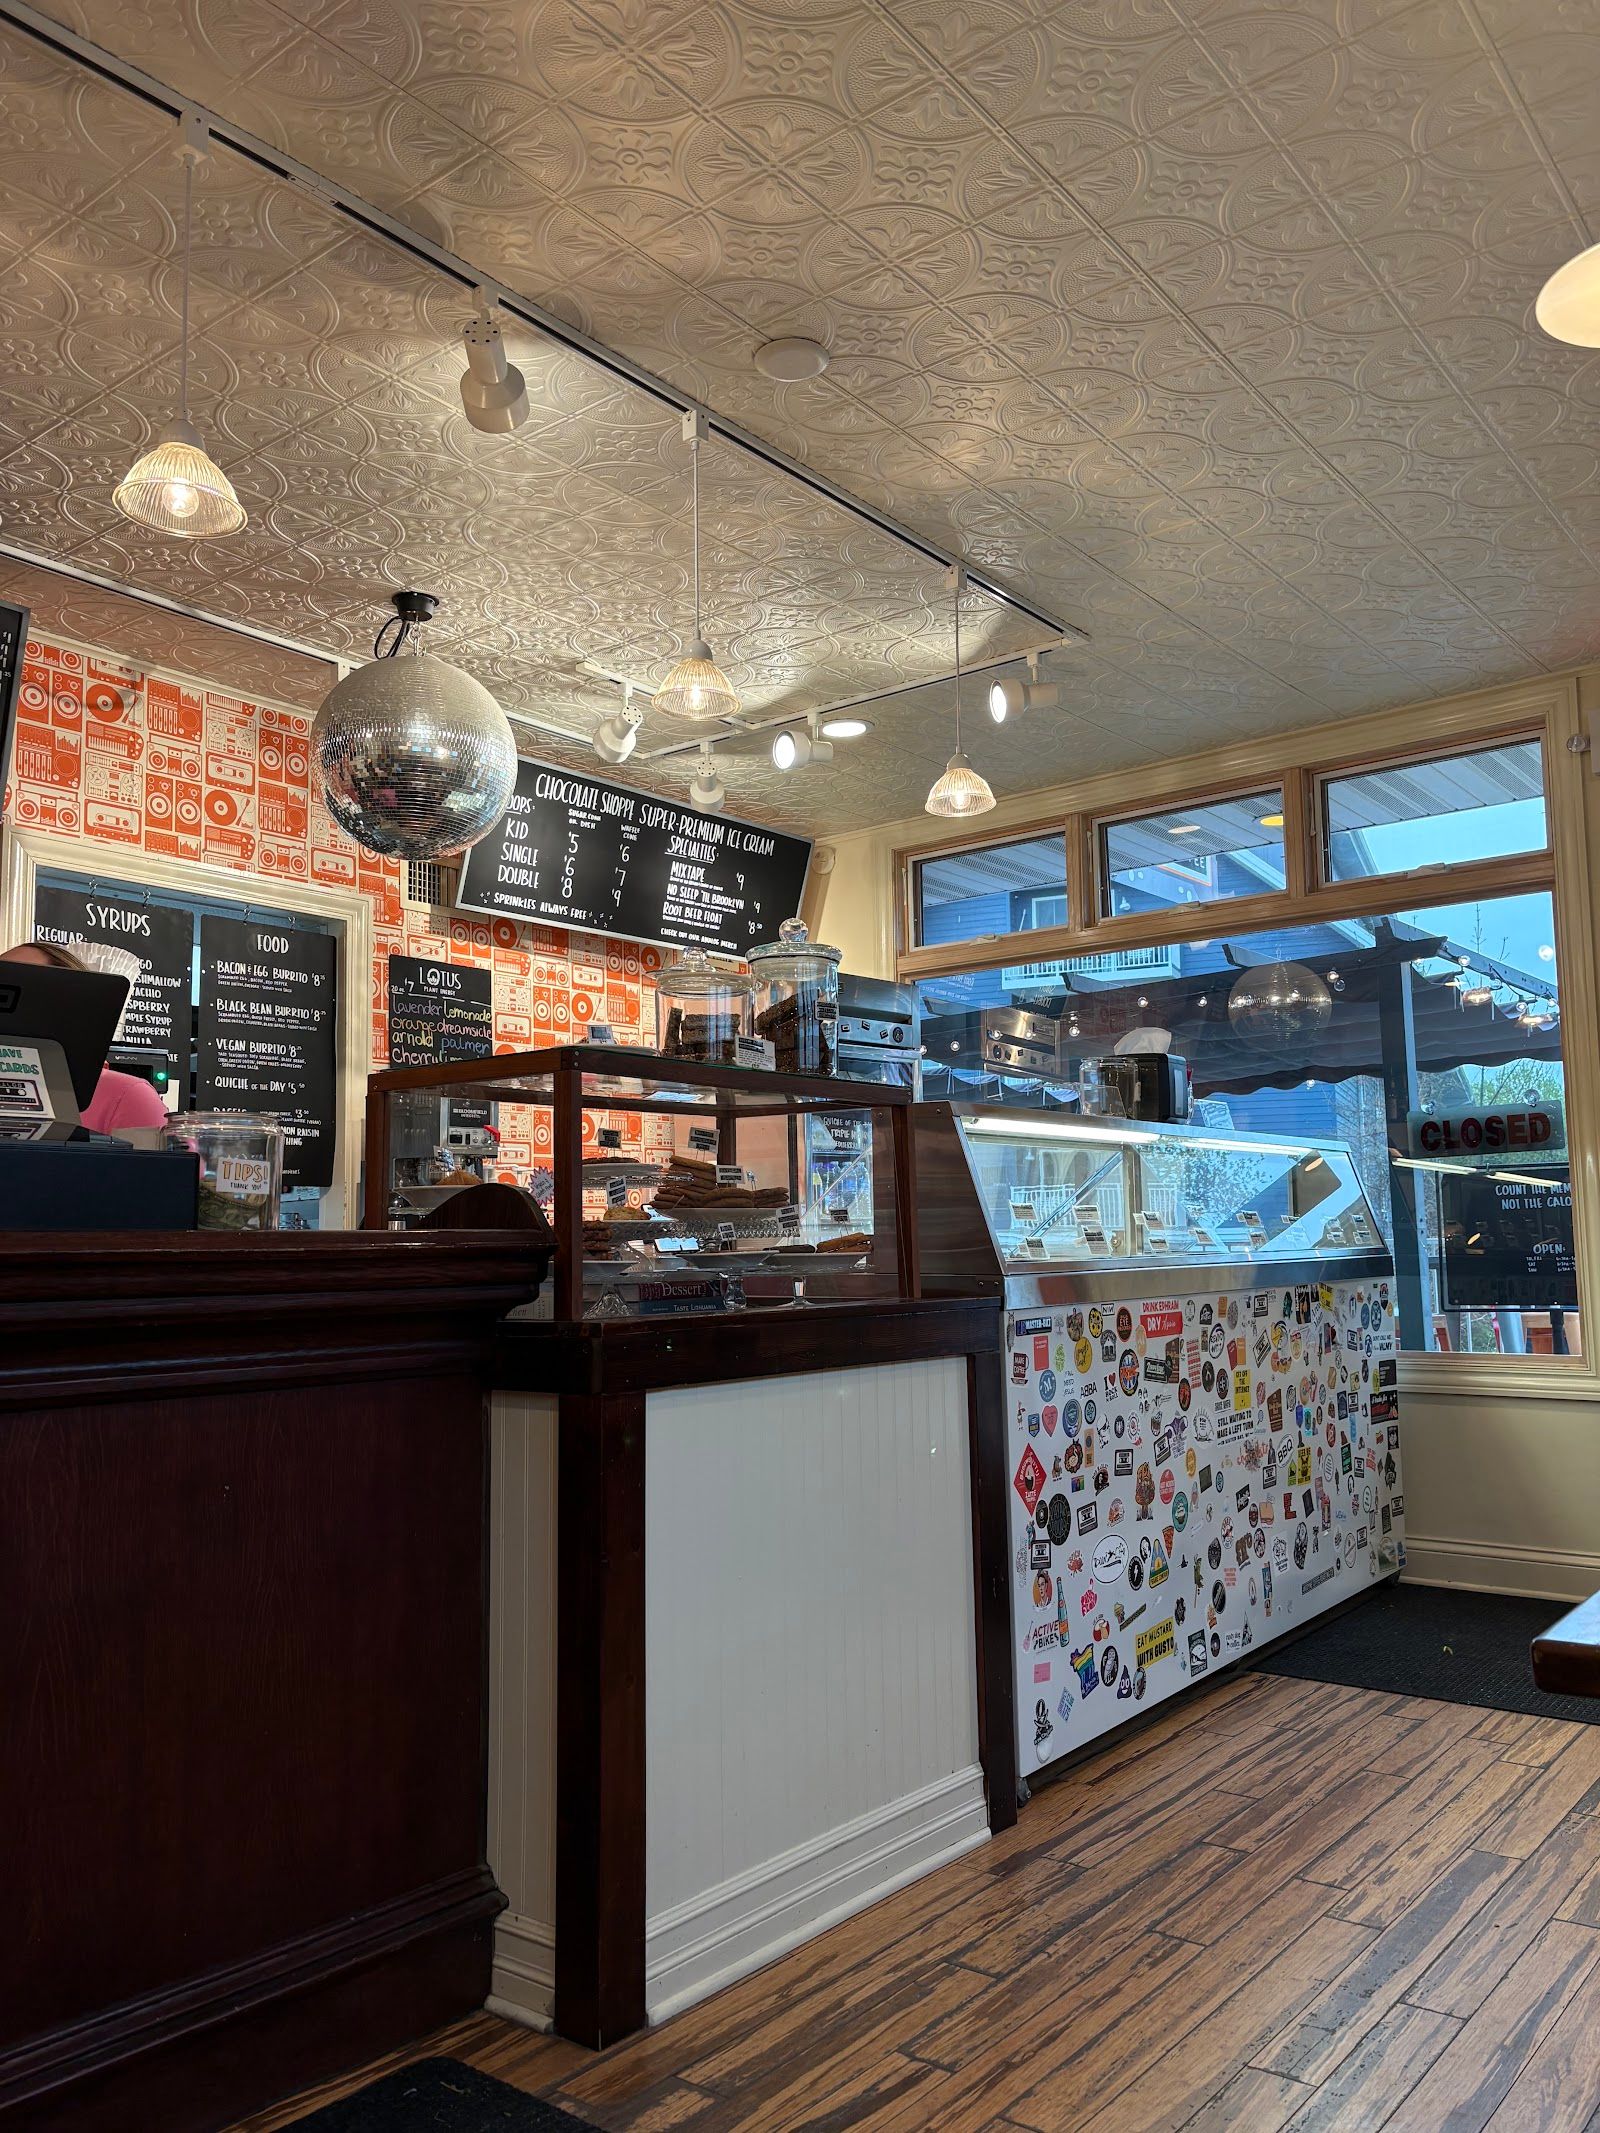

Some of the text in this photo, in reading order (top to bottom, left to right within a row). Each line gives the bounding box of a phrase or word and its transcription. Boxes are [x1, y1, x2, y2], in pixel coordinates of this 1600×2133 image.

[507, 795, 535, 813] OOPS:
[568, 809, 586, 819] SUGAR
[536, 774, 775, 856] CHOCOLATE SHOPPE SUPER-PREMIUM ICE CREAM
[580, 820, 595, 830] DISH
[620, 825, 640, 834] WAFFLE
[622, 832, 637, 841] CONE
[505, 818, 630, 862] KID $5 $6
[667, 835, 719, 862] SPECIALTIES:
[501, 842, 626, 887] SINGLE $6 $7
[498, 865, 621, 907] DOUBLE $8 $9
[670, 861, 706, 882] MIXTAPE
[736, 872, 745, 891] $9
[494, 892, 586, 920] SPRINKLES ALWAYS FREE
[667, 884, 677, 896] NO
[680, 886, 699, 900] SLEEP
[712, 894, 745, 910] BROOKLYN
[86, 902, 151, 936] SYRUPS
[662, 902, 682, 917] ROOT
[685, 907, 702, 921] BEER
[704, 912, 723, 924] FLOAT
[36, 925, 88, 944] REGULAR:
[257, 934, 289, 954] FOOD
[661, 928, 677, 937] CHECK
[701, 936, 719, 945] ANALOG
[721, 939, 738, 949] MERCH
[136, 975, 181, 988] SHMALLOW
[217, 960, 246, 975] BACON
[254, 965, 268, 977] EGG
[273, 968, 308, 984] BURRITO
[419, 966, 462, 990] LOTUS
[216, 998, 309, 1019] BLACK BEAN BURRITO
[393, 995, 492, 1023] lavender lemonade
[145, 1014, 172, 1026] SYRUP
[391, 1017, 493, 1040] orange dreamsicle
[216, 1038, 286, 1055] VEGAN BURRITO
[392, 1030, 490, 1054] arnold palmer
[215, 1075, 248, 1090] QUICHE
[270, 1081, 286, 1093] DAY
[297, 1128, 319, 1137] RAISIN
[1420, 1112, 1551, 1151] CLOSED
[222, 1160, 268, 1182] TIPS!
[1496, 1185, 1526, 1196] COUNT
[1531, 1184, 1547, 1194] THE
[1502, 1196, 1572, 1209] NOT THE CALO
[654, 1282, 701, 1296] Dessert
[674, 1304, 689, 1312] TASTE
[1143, 1302, 1158, 1312] DRINK
[1147, 1316, 1161, 1331] DRY
[1080, 1382, 1098, 1399] ABBA
[1104, 1376, 1109, 1390] I
[1105, 1386, 1117, 1397] ROCK
[1218, 1410, 1251, 1427] STILL WAITING TO
[1217, 1428, 1228, 1439] MAKE
[1232, 1423, 1242, 1434] LEFT
[1243, 1421, 1254, 1430] TURN
[1278, 1439, 1293, 1463] BBQ
[1033, 1620, 1059, 1640] ACTIVE
[1138, 1622, 1172, 1648] EAT MUSTARD
[1137, 1637, 1174, 1667] WITH GUSTO
